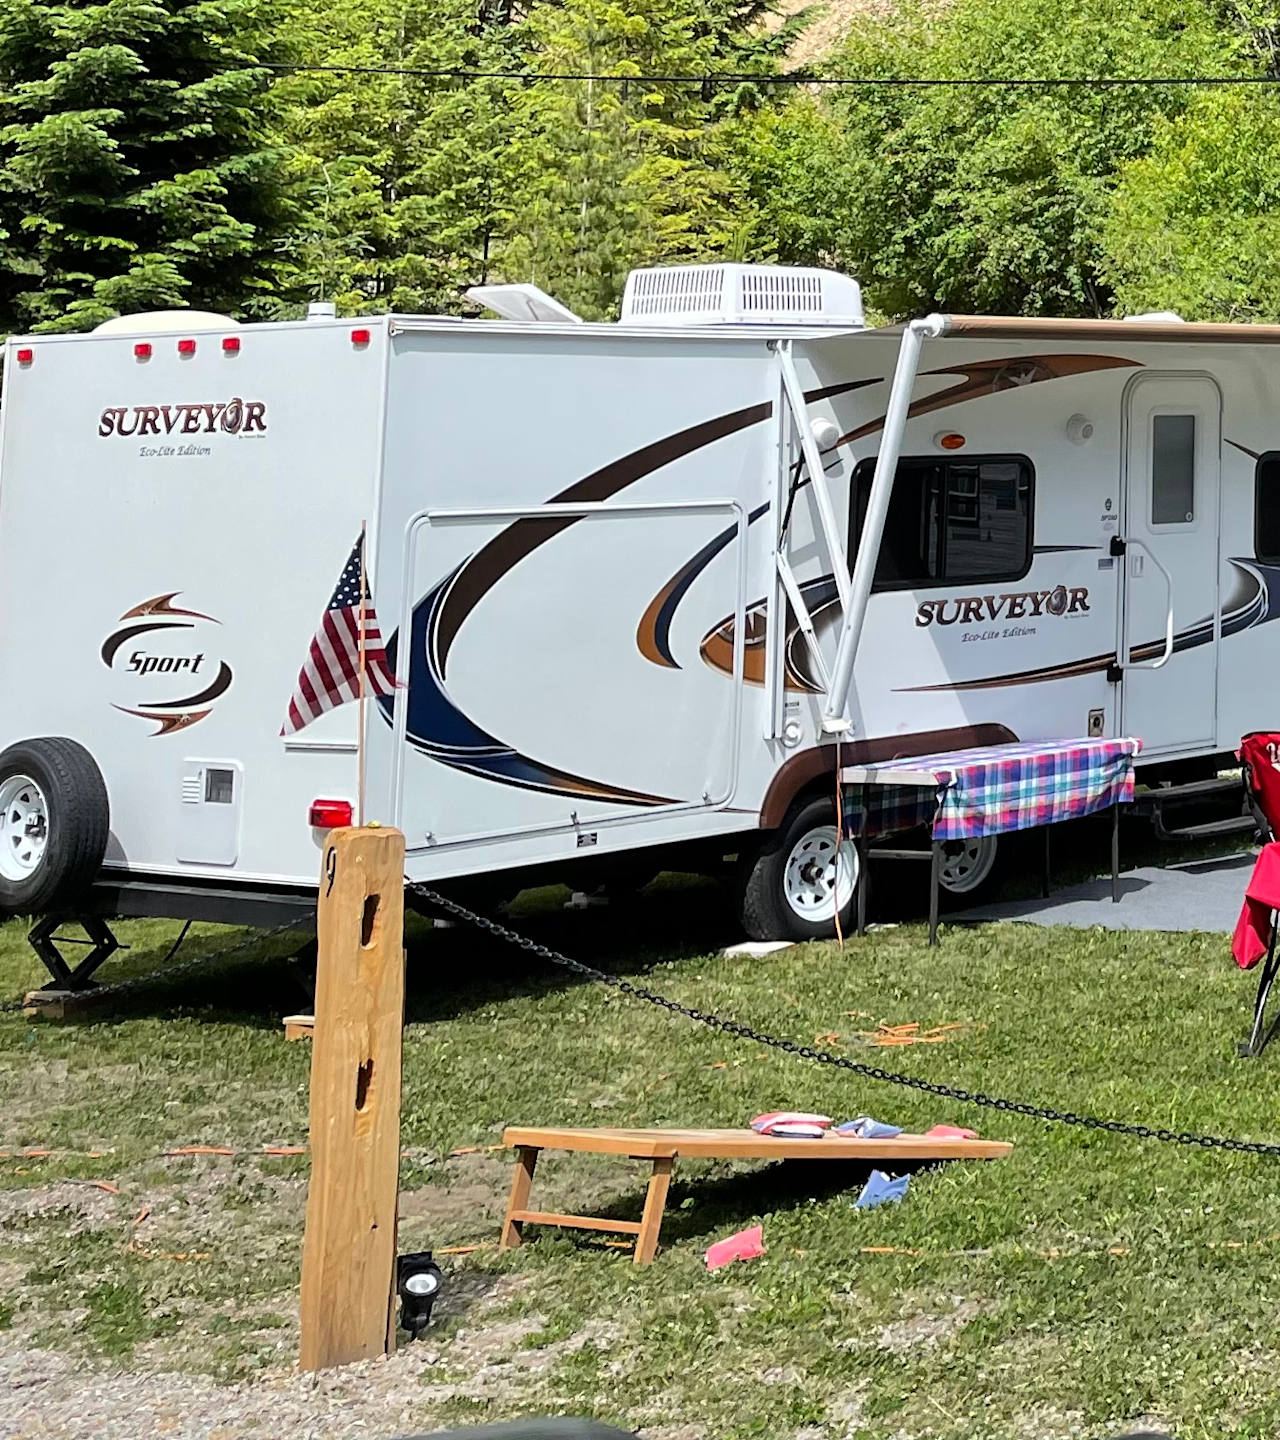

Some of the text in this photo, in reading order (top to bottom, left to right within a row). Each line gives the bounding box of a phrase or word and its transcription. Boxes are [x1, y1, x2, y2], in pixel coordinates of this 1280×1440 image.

[98, 398, 267, 437] SURVEYOR
[139, 444, 211, 457] Eco-Lite Edition
[915, 585, 1091, 627] SURVEYOR
[961, 626, 1037, 643] Eco-Lite Edition
[125, 651, 205, 675] Sport
[326, 846, 337, 898] 9
